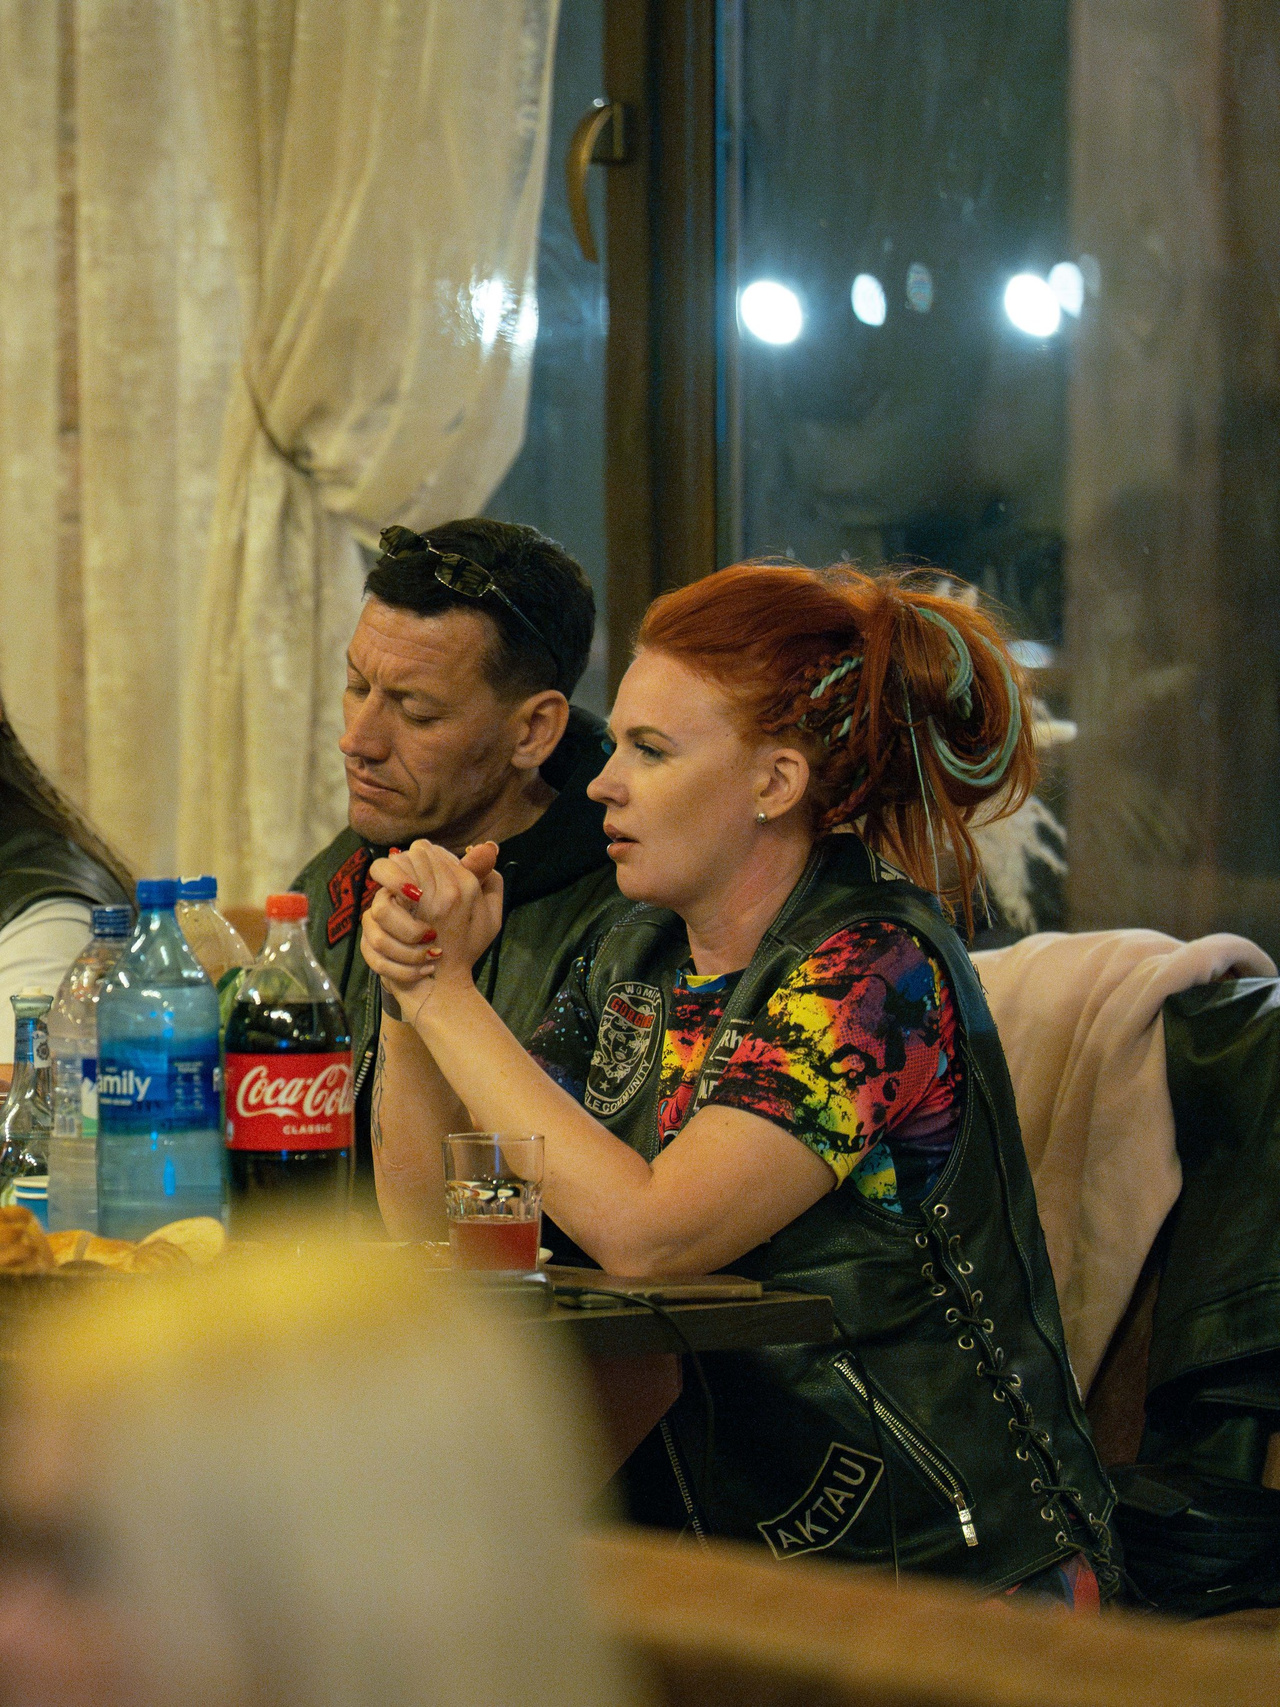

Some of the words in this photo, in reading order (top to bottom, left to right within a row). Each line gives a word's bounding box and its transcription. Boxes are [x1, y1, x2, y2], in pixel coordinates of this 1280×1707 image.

[96, 1069, 152, 1102] amily
[602, 1060, 651, 1113] COMMUNITY
[282, 1123, 333, 1136] CLASSIC
[777, 1456, 866, 1549] AKTAU
